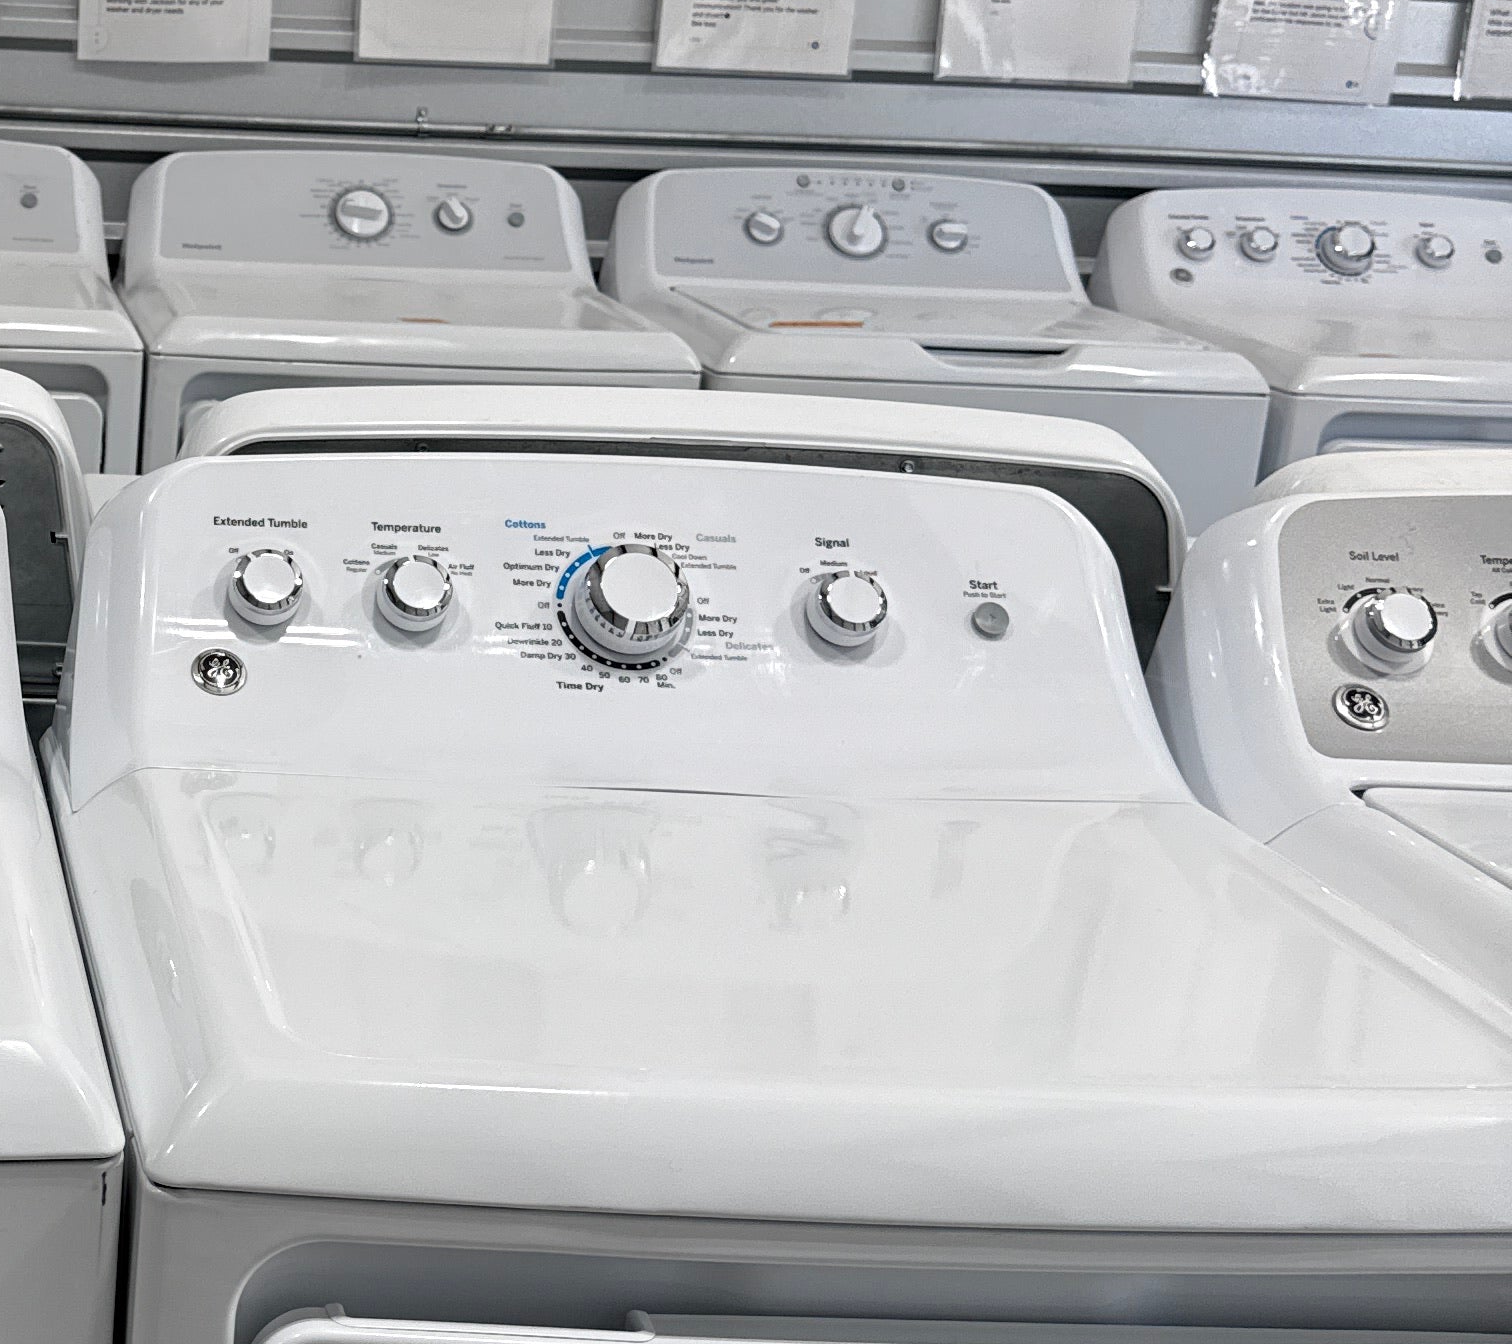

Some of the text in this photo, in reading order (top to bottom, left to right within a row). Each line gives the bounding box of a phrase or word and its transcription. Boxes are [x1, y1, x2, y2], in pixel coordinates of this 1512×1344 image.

[213, 516, 308, 530] Extended Tumble
[372, 521, 441, 534] Temperature
[505, 520, 546, 529] Cottons
[634, 533, 672, 542] More Dry
[696, 534, 736, 544] Casuals
[418, 544, 449, 552] Delicates
[672, 543, 690, 552] Dry
[815, 537, 850, 549] Signal
[535, 549, 570, 558] Less Dry
[1349, 551, 1399, 562] Soil Level
[503, 563, 560, 573] Optimum Dry
[513, 579, 551, 588] More Dry
[969, 580, 998, 590] Start
[697, 597, 709, 605] Off
[699, 614, 737, 624] More Dry
[495, 622, 520, 630] Quick
[521, 622, 541, 630] Fluff
[715, 630, 734, 639] Dry
[726, 641, 773, 651] Delicates
[521, 651, 576, 661] Damp Dry 30
[556, 682, 604, 692] Time Dry
